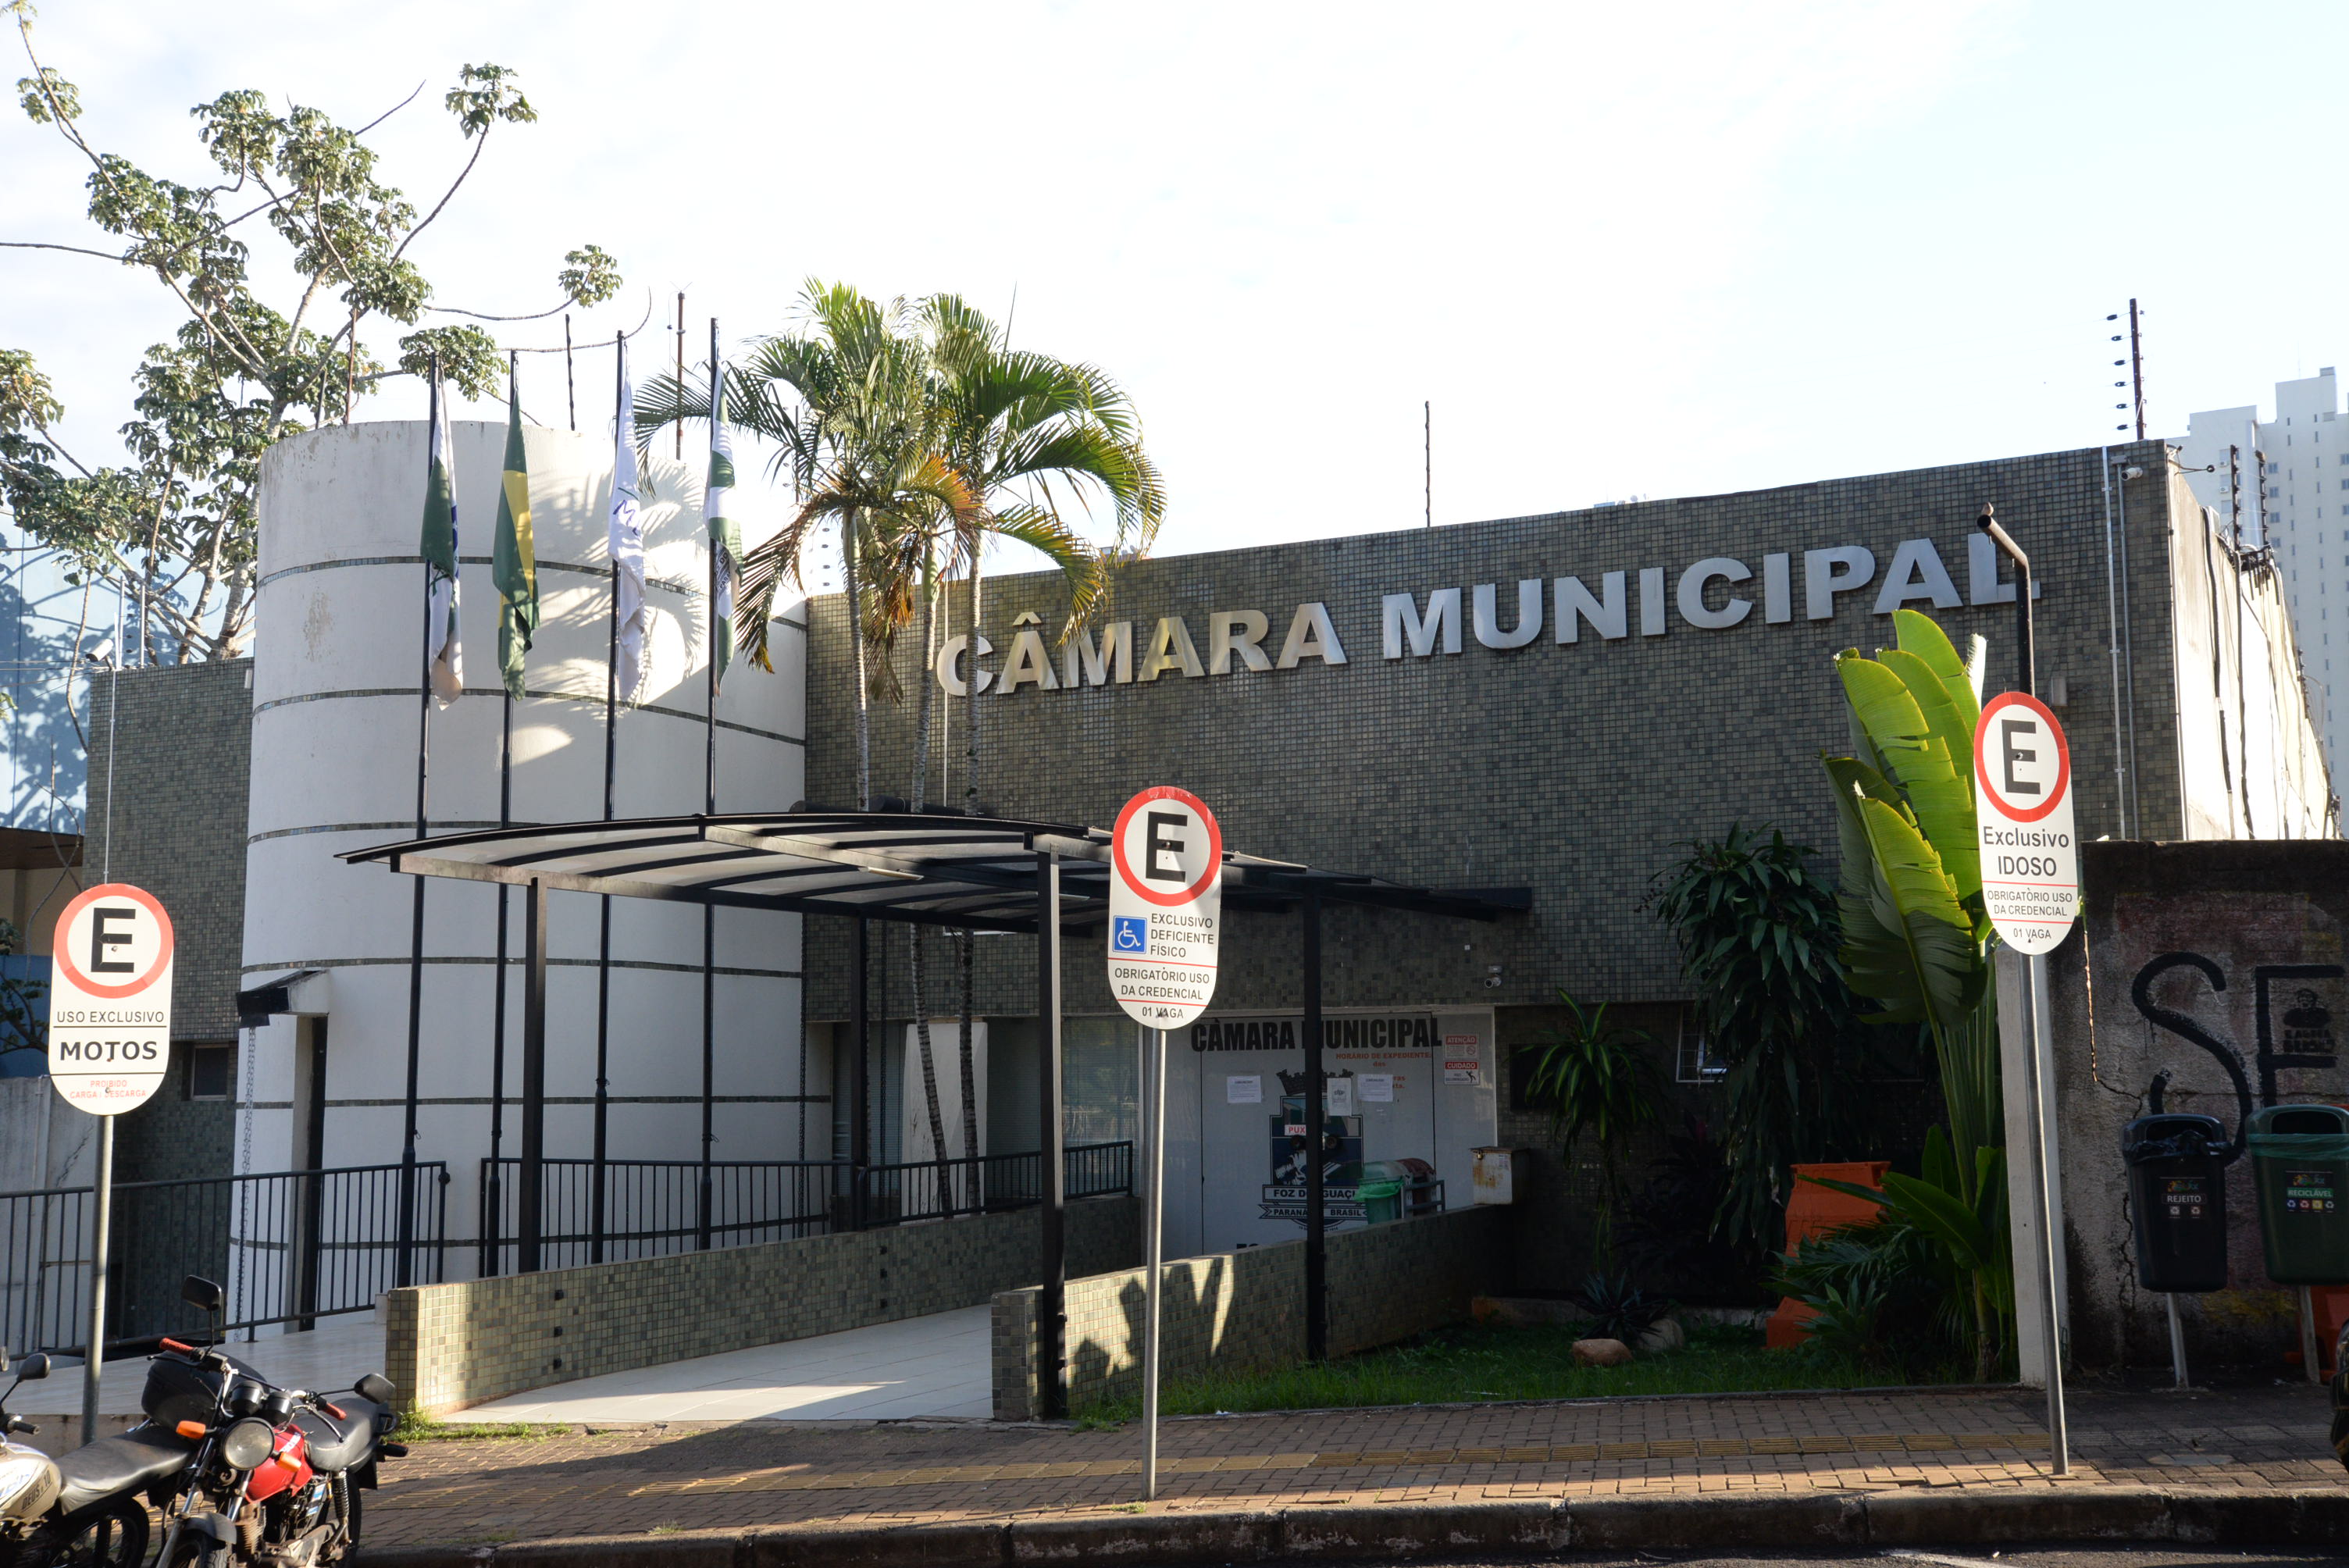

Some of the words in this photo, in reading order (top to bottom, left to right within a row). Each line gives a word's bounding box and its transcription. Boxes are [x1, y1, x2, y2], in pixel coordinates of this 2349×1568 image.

[936, 602, 1348, 697] CÂMARA
[1382, 533, 2041, 659] MUNICIPAL
[2001, 719, 2041, 795] E
[1983, 825, 2069, 849] Exclusivo
[1146, 811, 1188, 882] E
[1998, 855, 2057, 877] IDOSO
[2052, 893, 2073, 903] USO
[1994, 904, 2006, 914] DA
[2008, 904, 2067, 916] CREDENCIAL
[1150, 913, 1213, 928] EXCLUSIVO
[91, 907, 137, 973] E
[1150, 929, 1214, 945] DEFICIENTE
[2013, 928, 2023, 938] 01
[2025, 928, 2051, 939] VAGA
[1150, 943, 1186, 958] FÍSICO
[1189, 972, 1210, 985] USO
[1121, 985, 1135, 996] DA
[1139, 985, 1203, 1000] CREDENCIAL
[57, 1011, 85, 1023] USO
[90, 1010, 164, 1023] EXCLUSIVO
[1142, 1006, 1152, 1017] 01
[1156, 1007, 1184, 1019] VAGA
[60, 1041, 157, 1060] MOTOS
[1274, 1189, 1295, 1198] FOZ
[1323, 1189, 1356, 1201] GUAÇ
[2287, 1188, 2333, 1197] RECICLÁVEL
